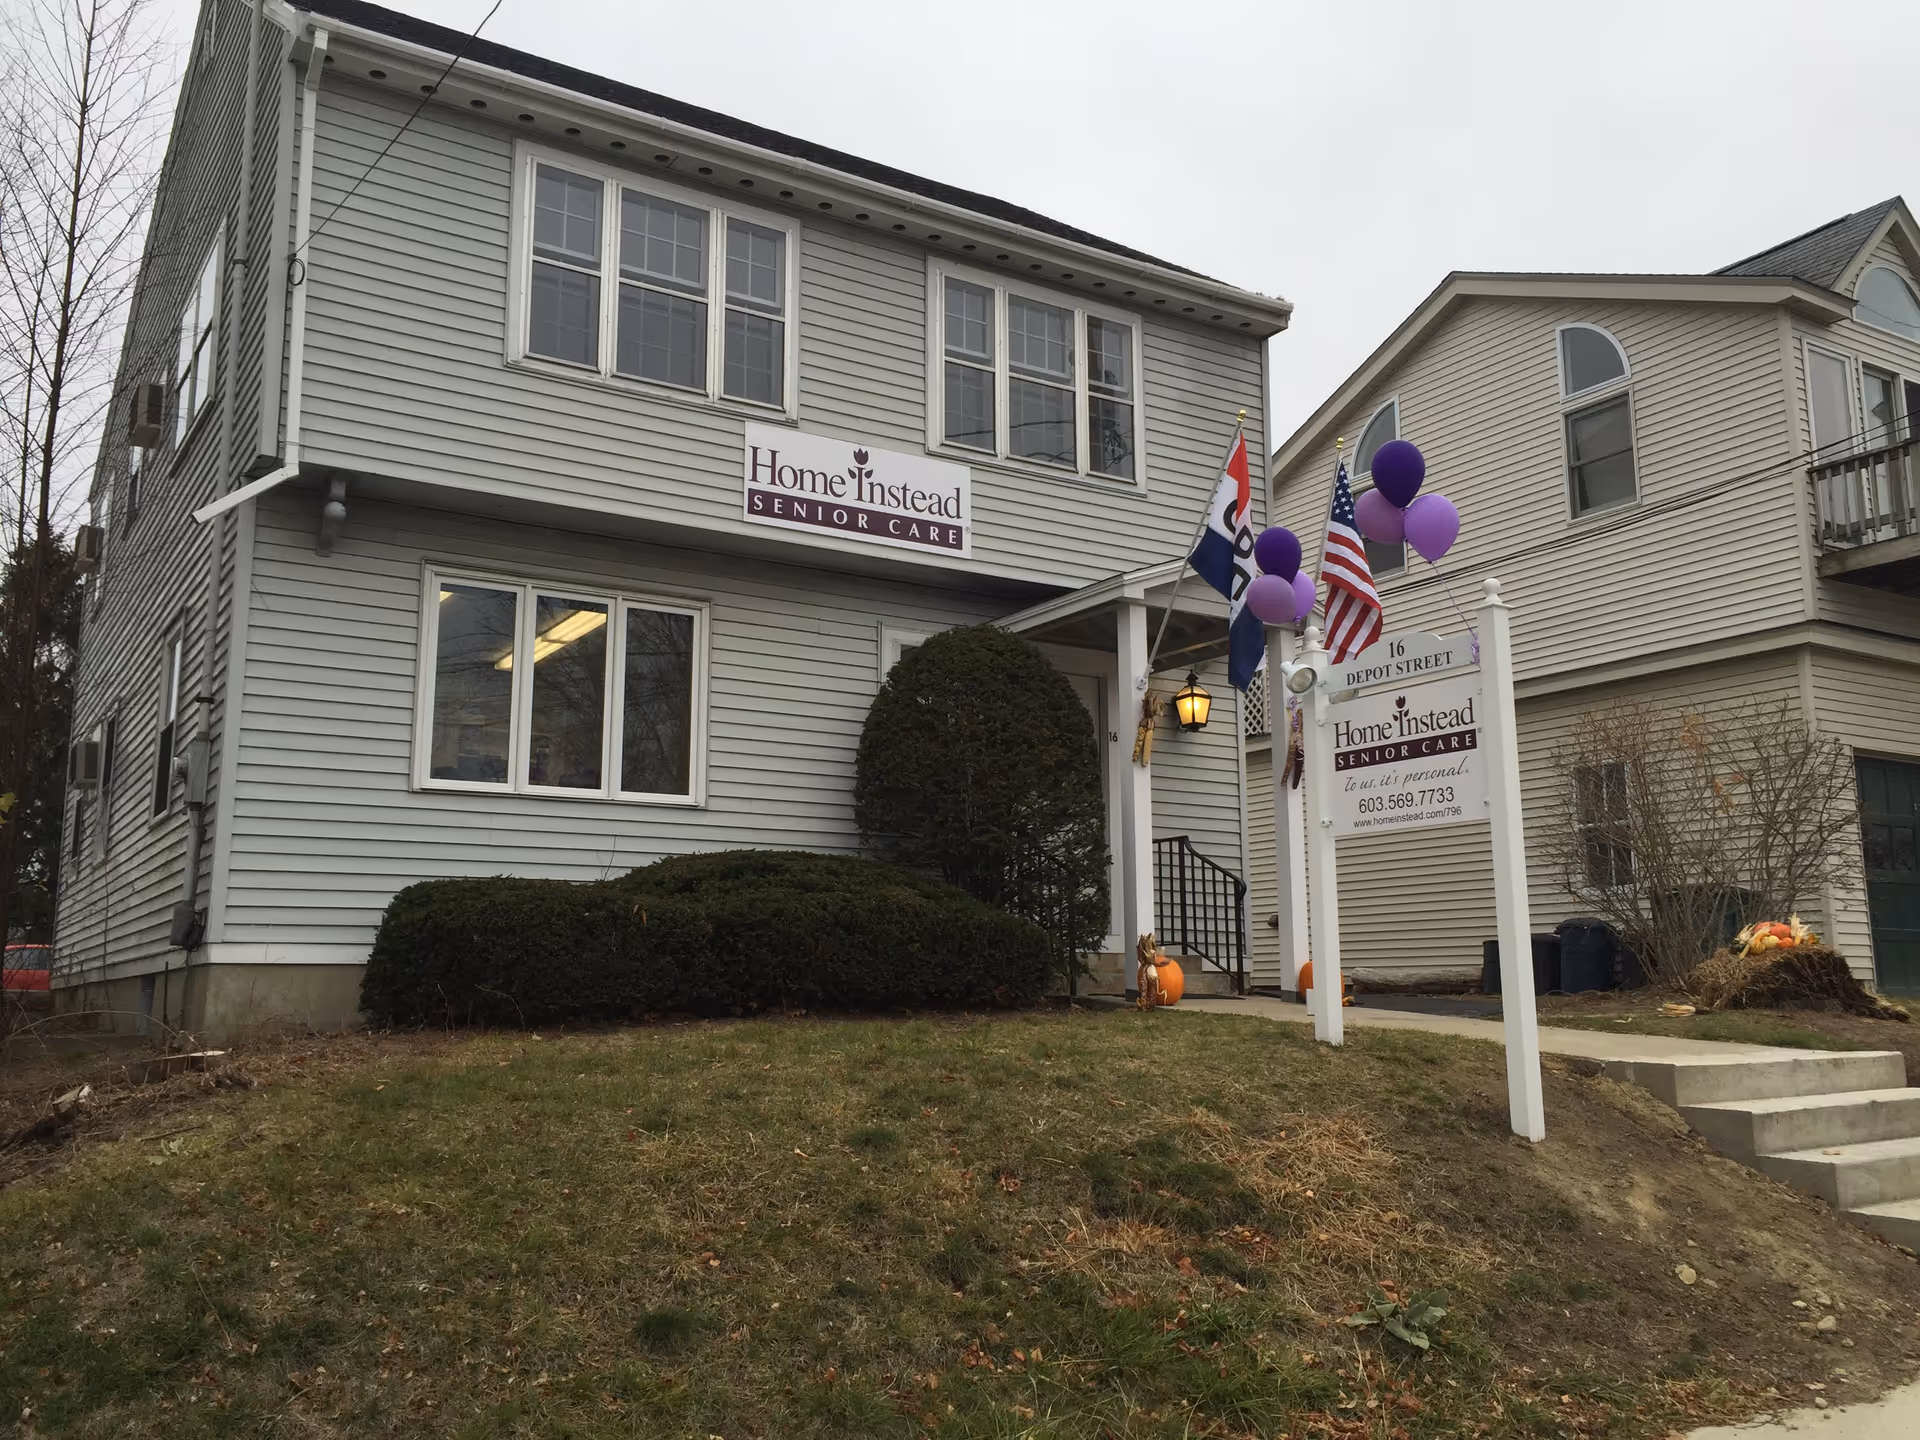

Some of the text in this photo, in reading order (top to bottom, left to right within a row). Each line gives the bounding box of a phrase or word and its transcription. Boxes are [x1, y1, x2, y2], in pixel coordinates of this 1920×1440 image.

[748, 445, 963, 519] Home Instead
[753, 494, 957, 545] SENIOR CARE
[1388, 639, 1405, 658] 16
[1346, 651, 1453, 686] DEPOT STREET
[1109, 732, 1118, 742] 16
[1333, 697, 1475, 748] Home Instead
[1338, 733, 1473, 768] SENIOR CARE
[1344, 776, 1357, 792] To
[1380, 769, 1399, 786] it's
[1358, 786, 1455, 814] 603.569.7733
[1353, 805, 1462, 828] www.homeinstead.com/796
